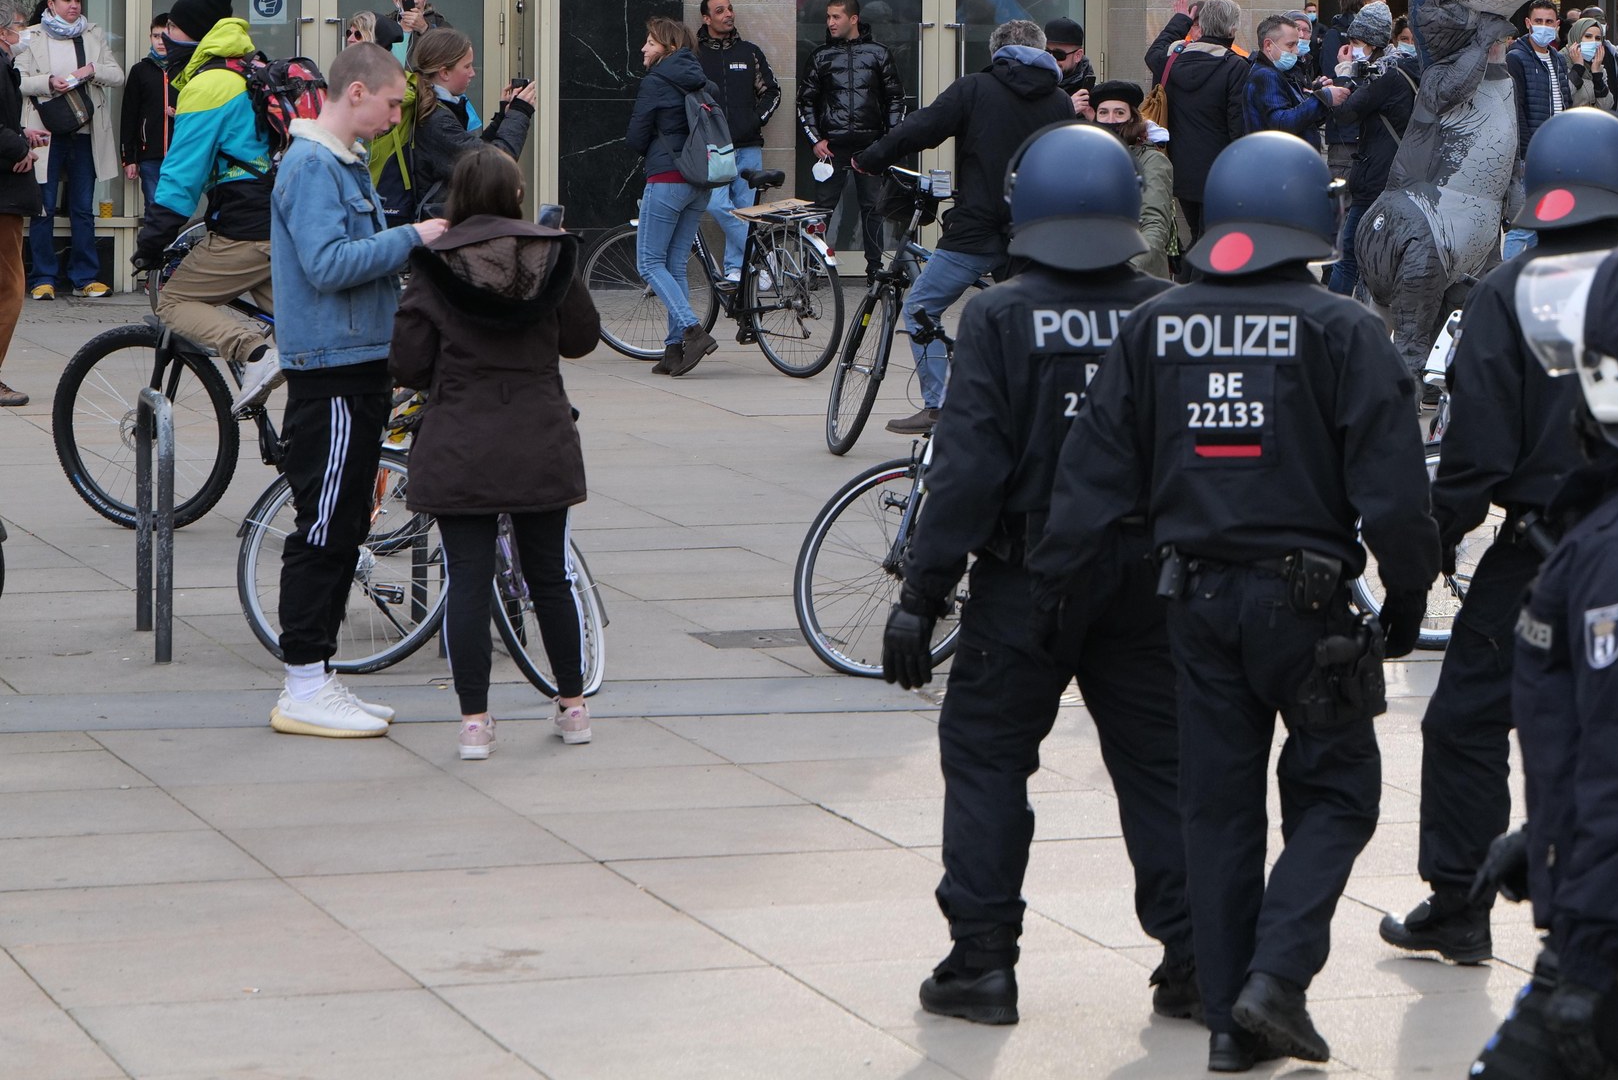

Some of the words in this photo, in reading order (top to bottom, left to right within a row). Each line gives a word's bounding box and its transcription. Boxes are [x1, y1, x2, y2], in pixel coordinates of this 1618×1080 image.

[1032, 309, 1132, 348] POLI
[1156, 314, 1297, 357] POLIZEI
[1208, 372, 1244, 399] BE
[1187, 401, 1265, 429] 22133
